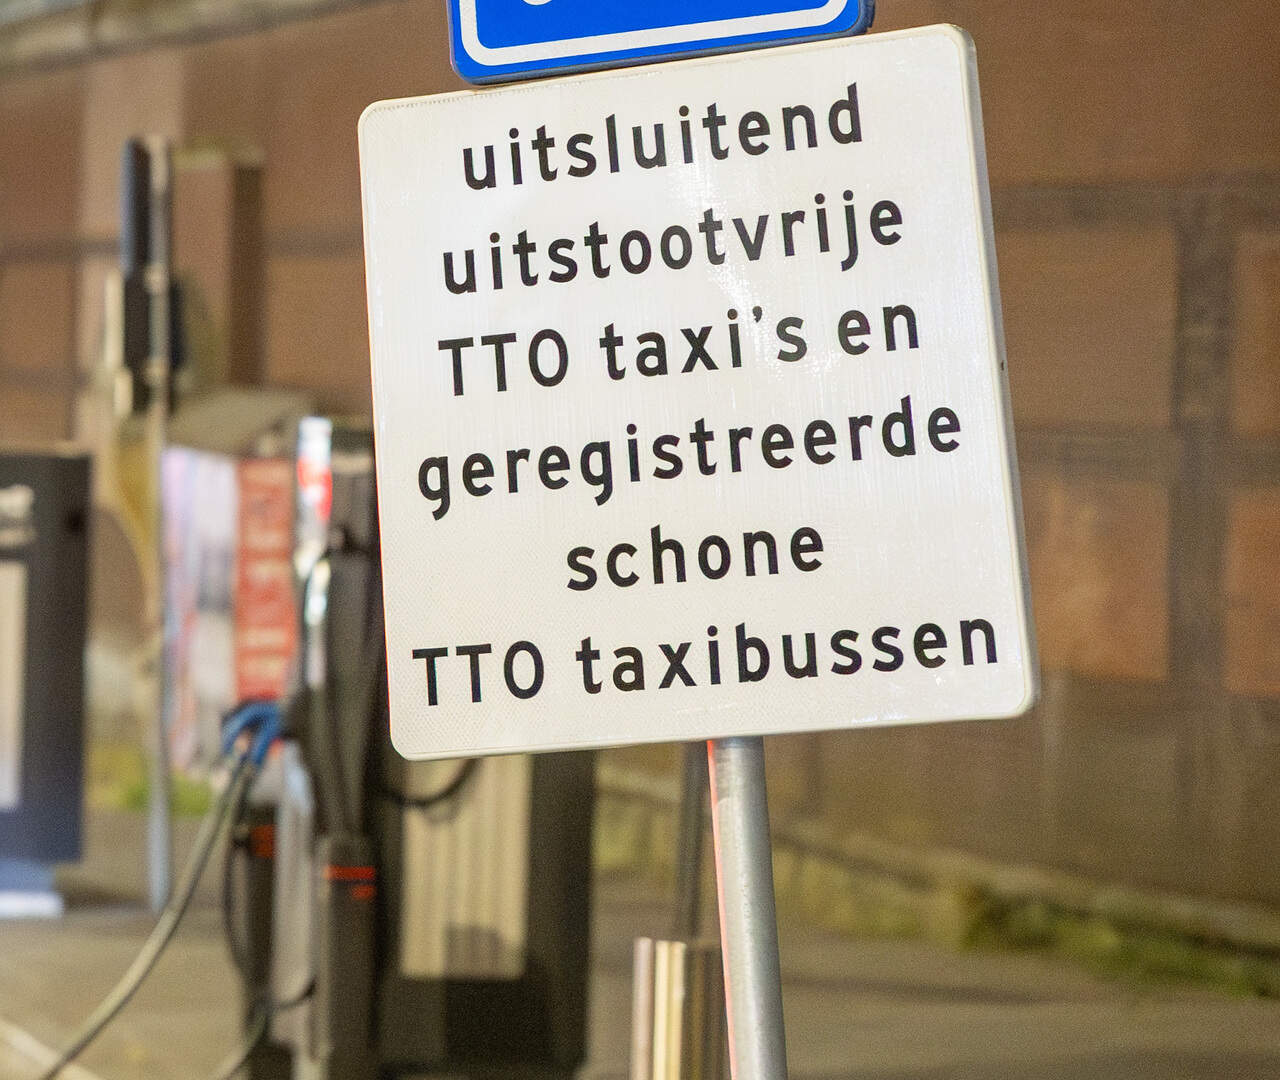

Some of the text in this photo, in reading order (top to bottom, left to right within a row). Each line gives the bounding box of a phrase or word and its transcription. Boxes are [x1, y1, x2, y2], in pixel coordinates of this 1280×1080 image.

[462, 82, 864, 190] uitsluitend
[443, 189, 904, 294] uitstootvrije
[438, 328, 569, 397] TTO
[837, 304, 919, 356] en
[418, 395, 962, 520] geregistreerde
[566, 524, 824, 591] schone
[412, 618, 998, 707] TTO taxibussen
